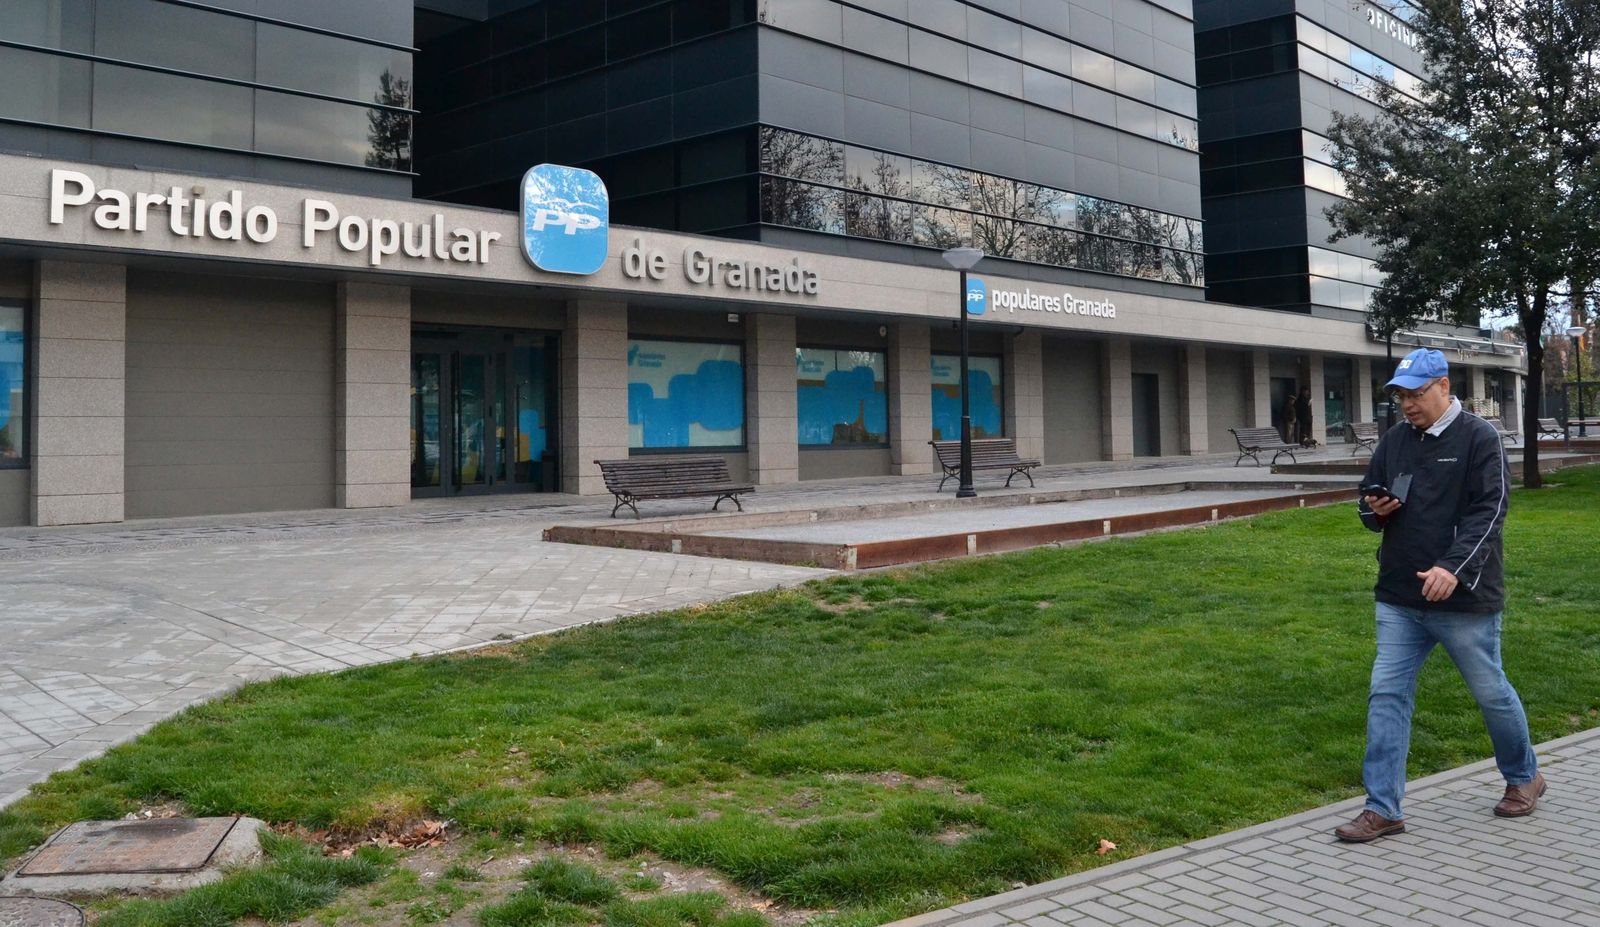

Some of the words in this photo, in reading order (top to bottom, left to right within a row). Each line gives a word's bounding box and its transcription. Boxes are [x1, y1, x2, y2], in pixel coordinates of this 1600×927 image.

[1367, 8, 1425, 54] OFICINA
[49, 168, 278, 244] Partido
[303, 198, 502, 266] Popular
[532, 208, 601, 236] PP
[622, 238, 669, 281] de
[683, 246, 822, 295] Granada
[967, 293, 984, 302] PP
[992, 288, 1062, 313] populares
[1063, 293, 1117, 318] Granada
